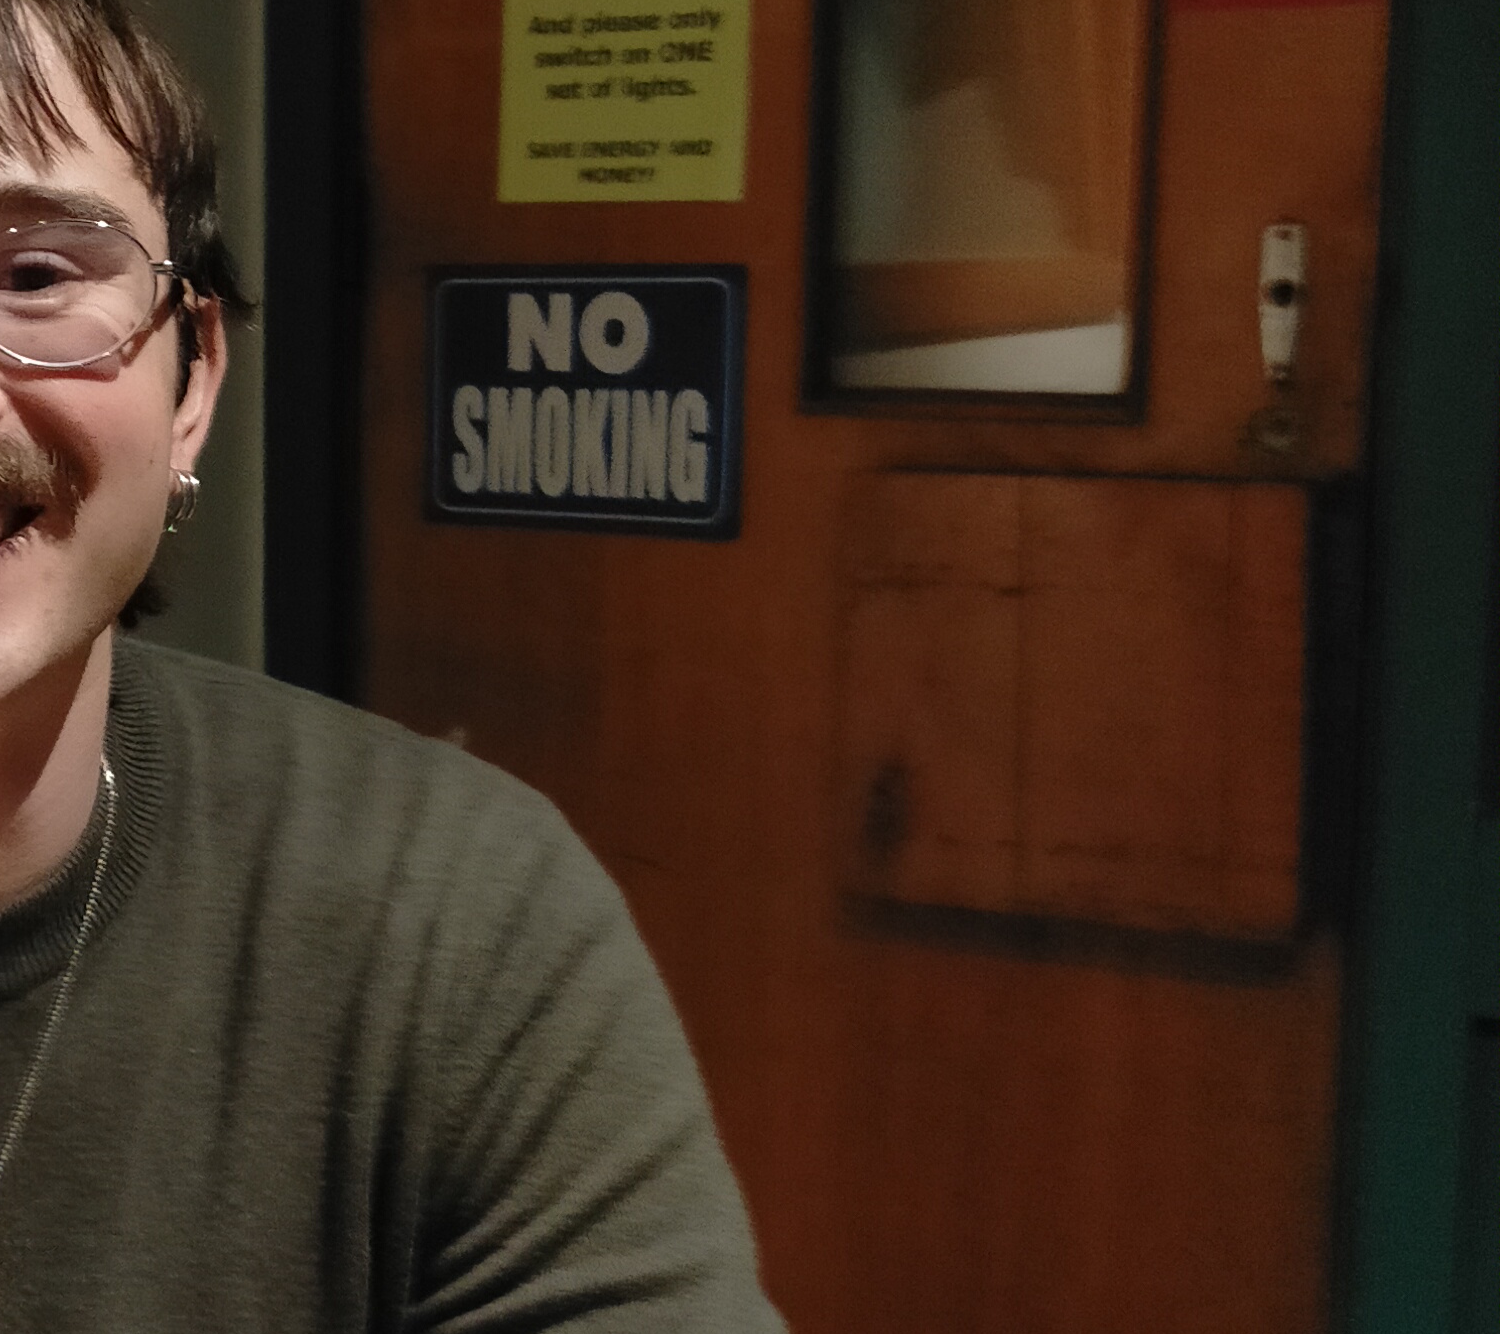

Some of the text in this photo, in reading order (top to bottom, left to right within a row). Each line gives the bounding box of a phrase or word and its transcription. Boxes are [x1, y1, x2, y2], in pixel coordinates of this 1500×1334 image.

[581, 12, 660, 37] please
[668, 8, 721, 32] only
[534, 41, 714, 67] switch on ONE
[545, 80, 583, 100] set
[587, 78, 612, 99] of
[580, 140, 661, 158] ENERGY
[506, 290, 650, 375] NO
[452, 383, 712, 504] SMOKING
